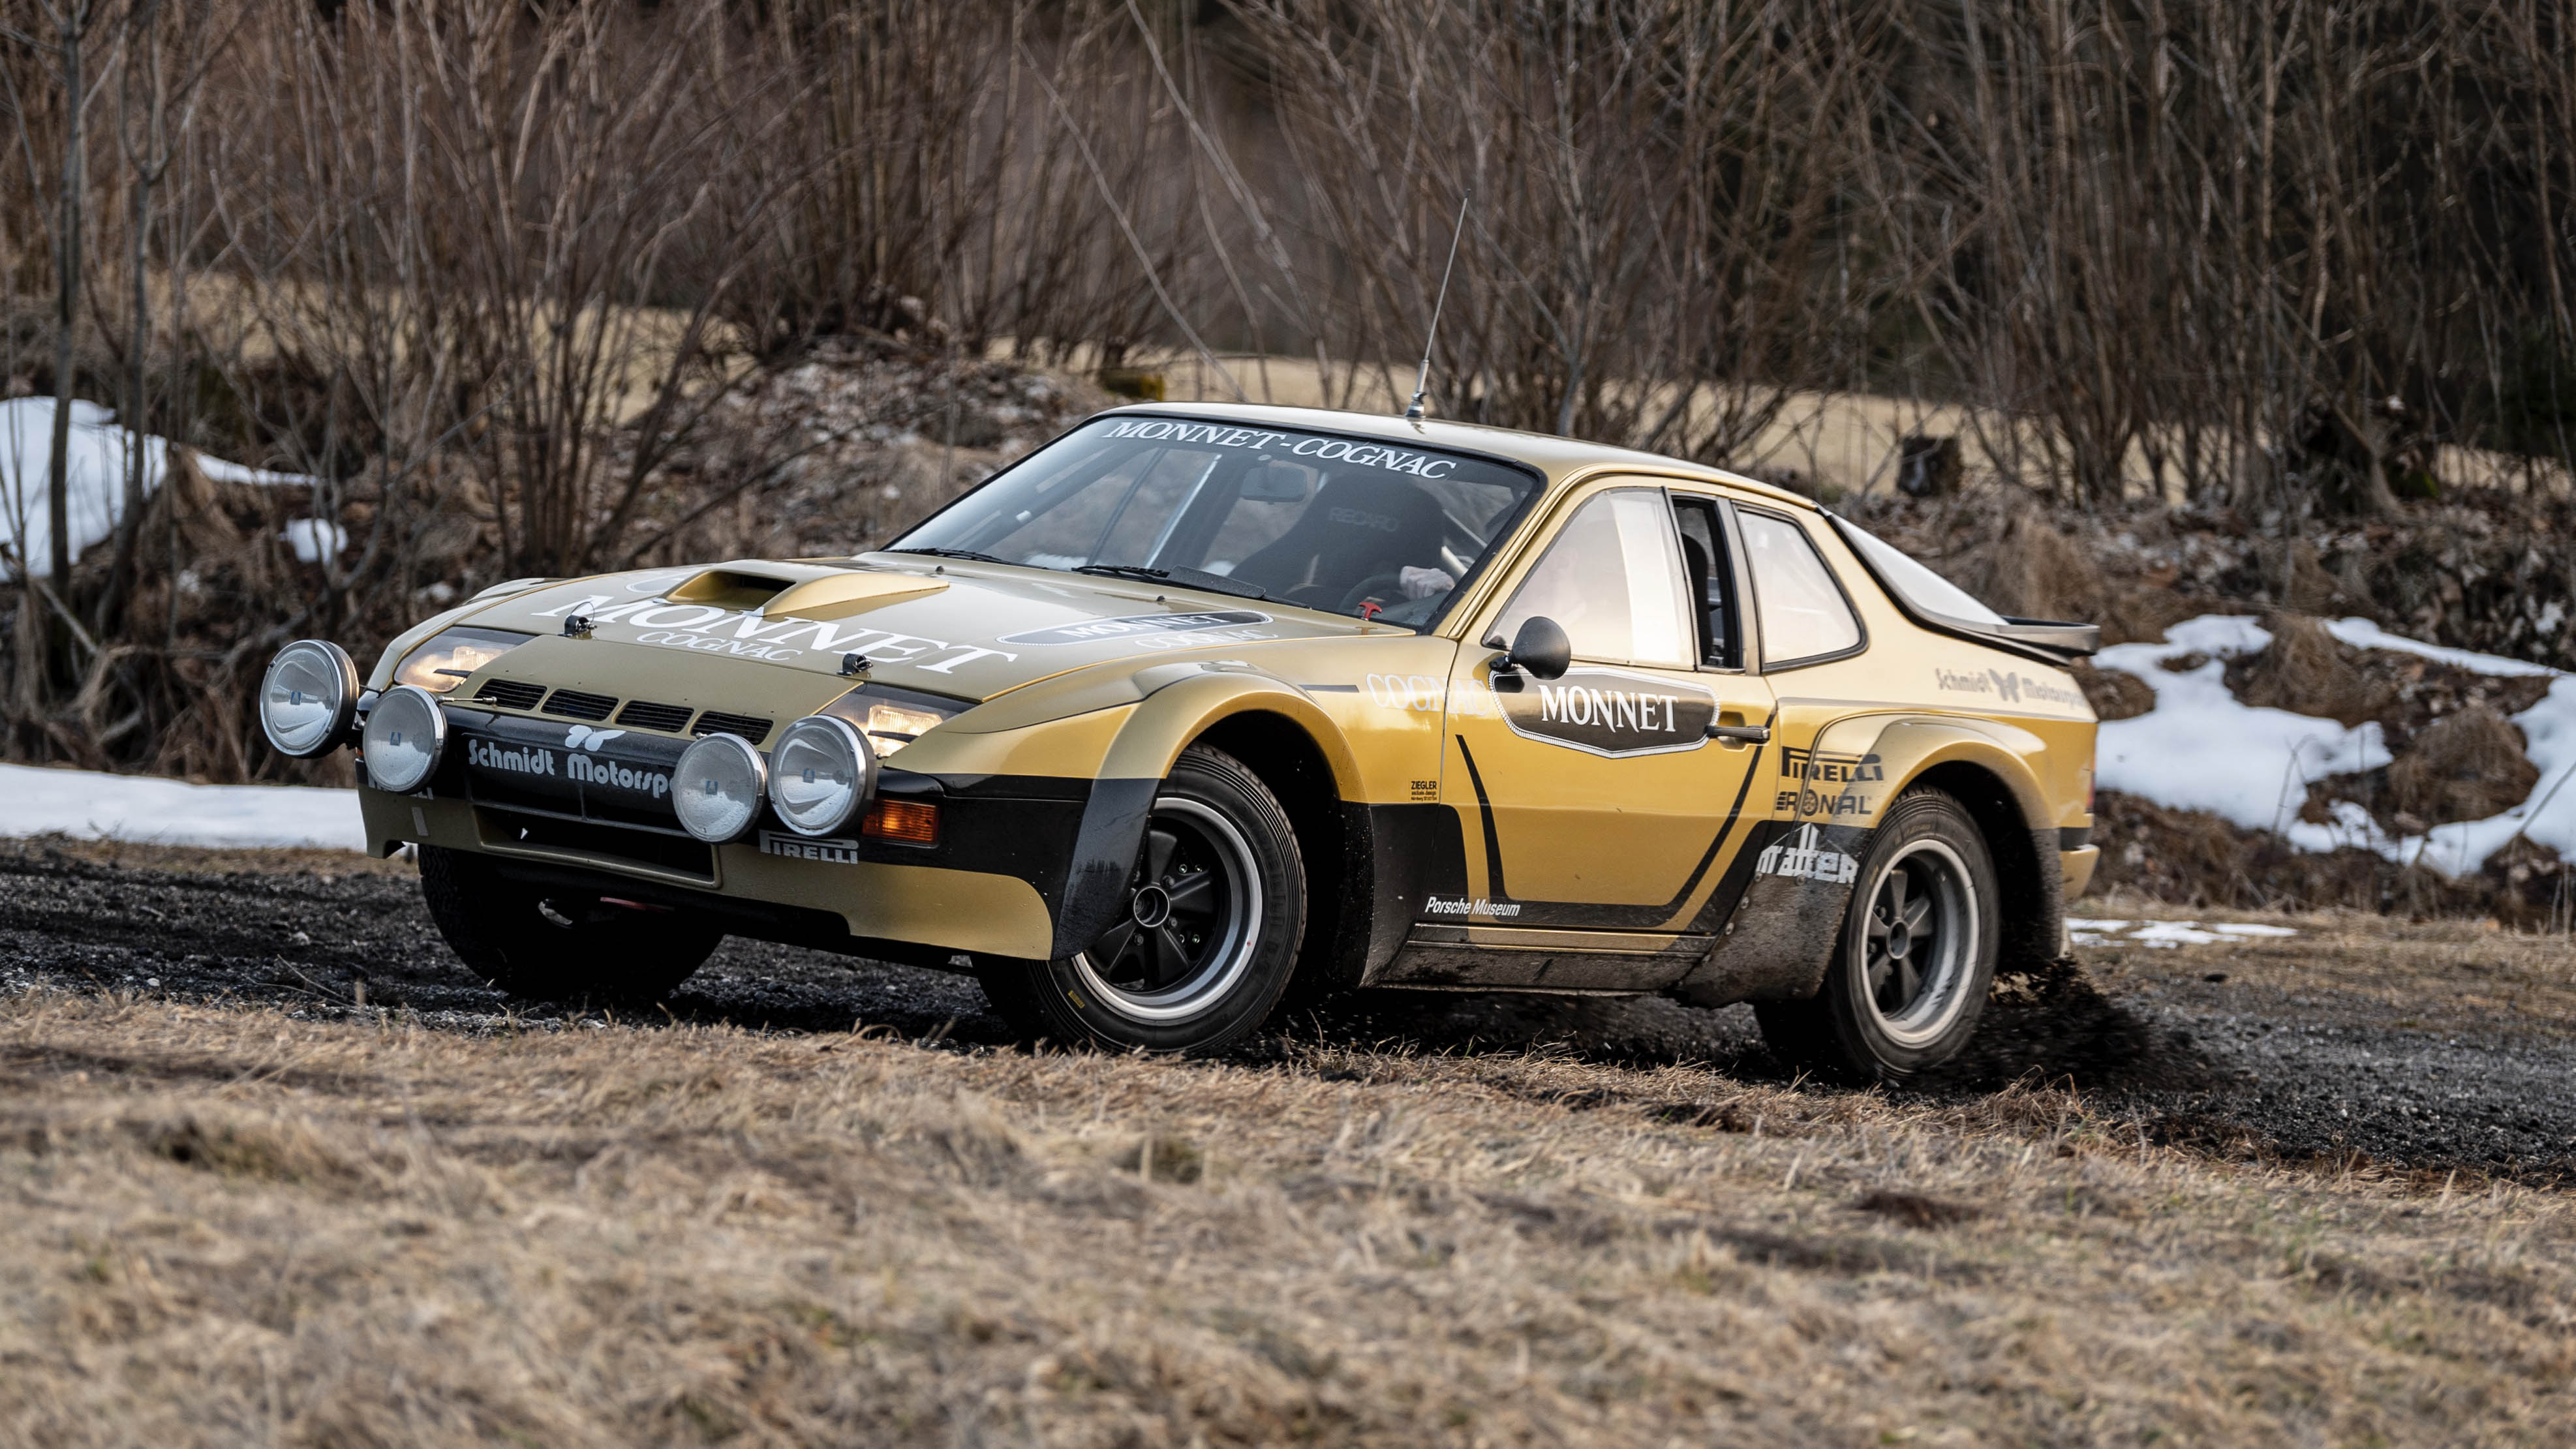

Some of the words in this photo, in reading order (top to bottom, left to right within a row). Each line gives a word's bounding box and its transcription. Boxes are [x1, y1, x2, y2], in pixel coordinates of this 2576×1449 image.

[1103, 421, 1456, 480] MONNET-COGNAC
[530, 595, 1018, 675] MONNET
[1055, 615, 1231, 638] MONNET
[1134, 629, 1278, 649] COGNAC
[636, 631, 803, 662] COGNAC
[1366, 673, 1490, 716] COGNAC
[1935, 668, 1993, 693] Schmidt
[1538, 685, 1679, 733] MONNET
[468, 739, 555, 776] Schmidt
[1781, 746, 1884, 782] PIRELLI
[1411, 780, 1437, 790] ZIEGLER
[1776, 789, 1872, 816] RONAL
[759, 829, 859, 864] PIRELLI
[1425, 896, 1471, 915] Porsche
[1471, 898, 1521, 917] Museum
